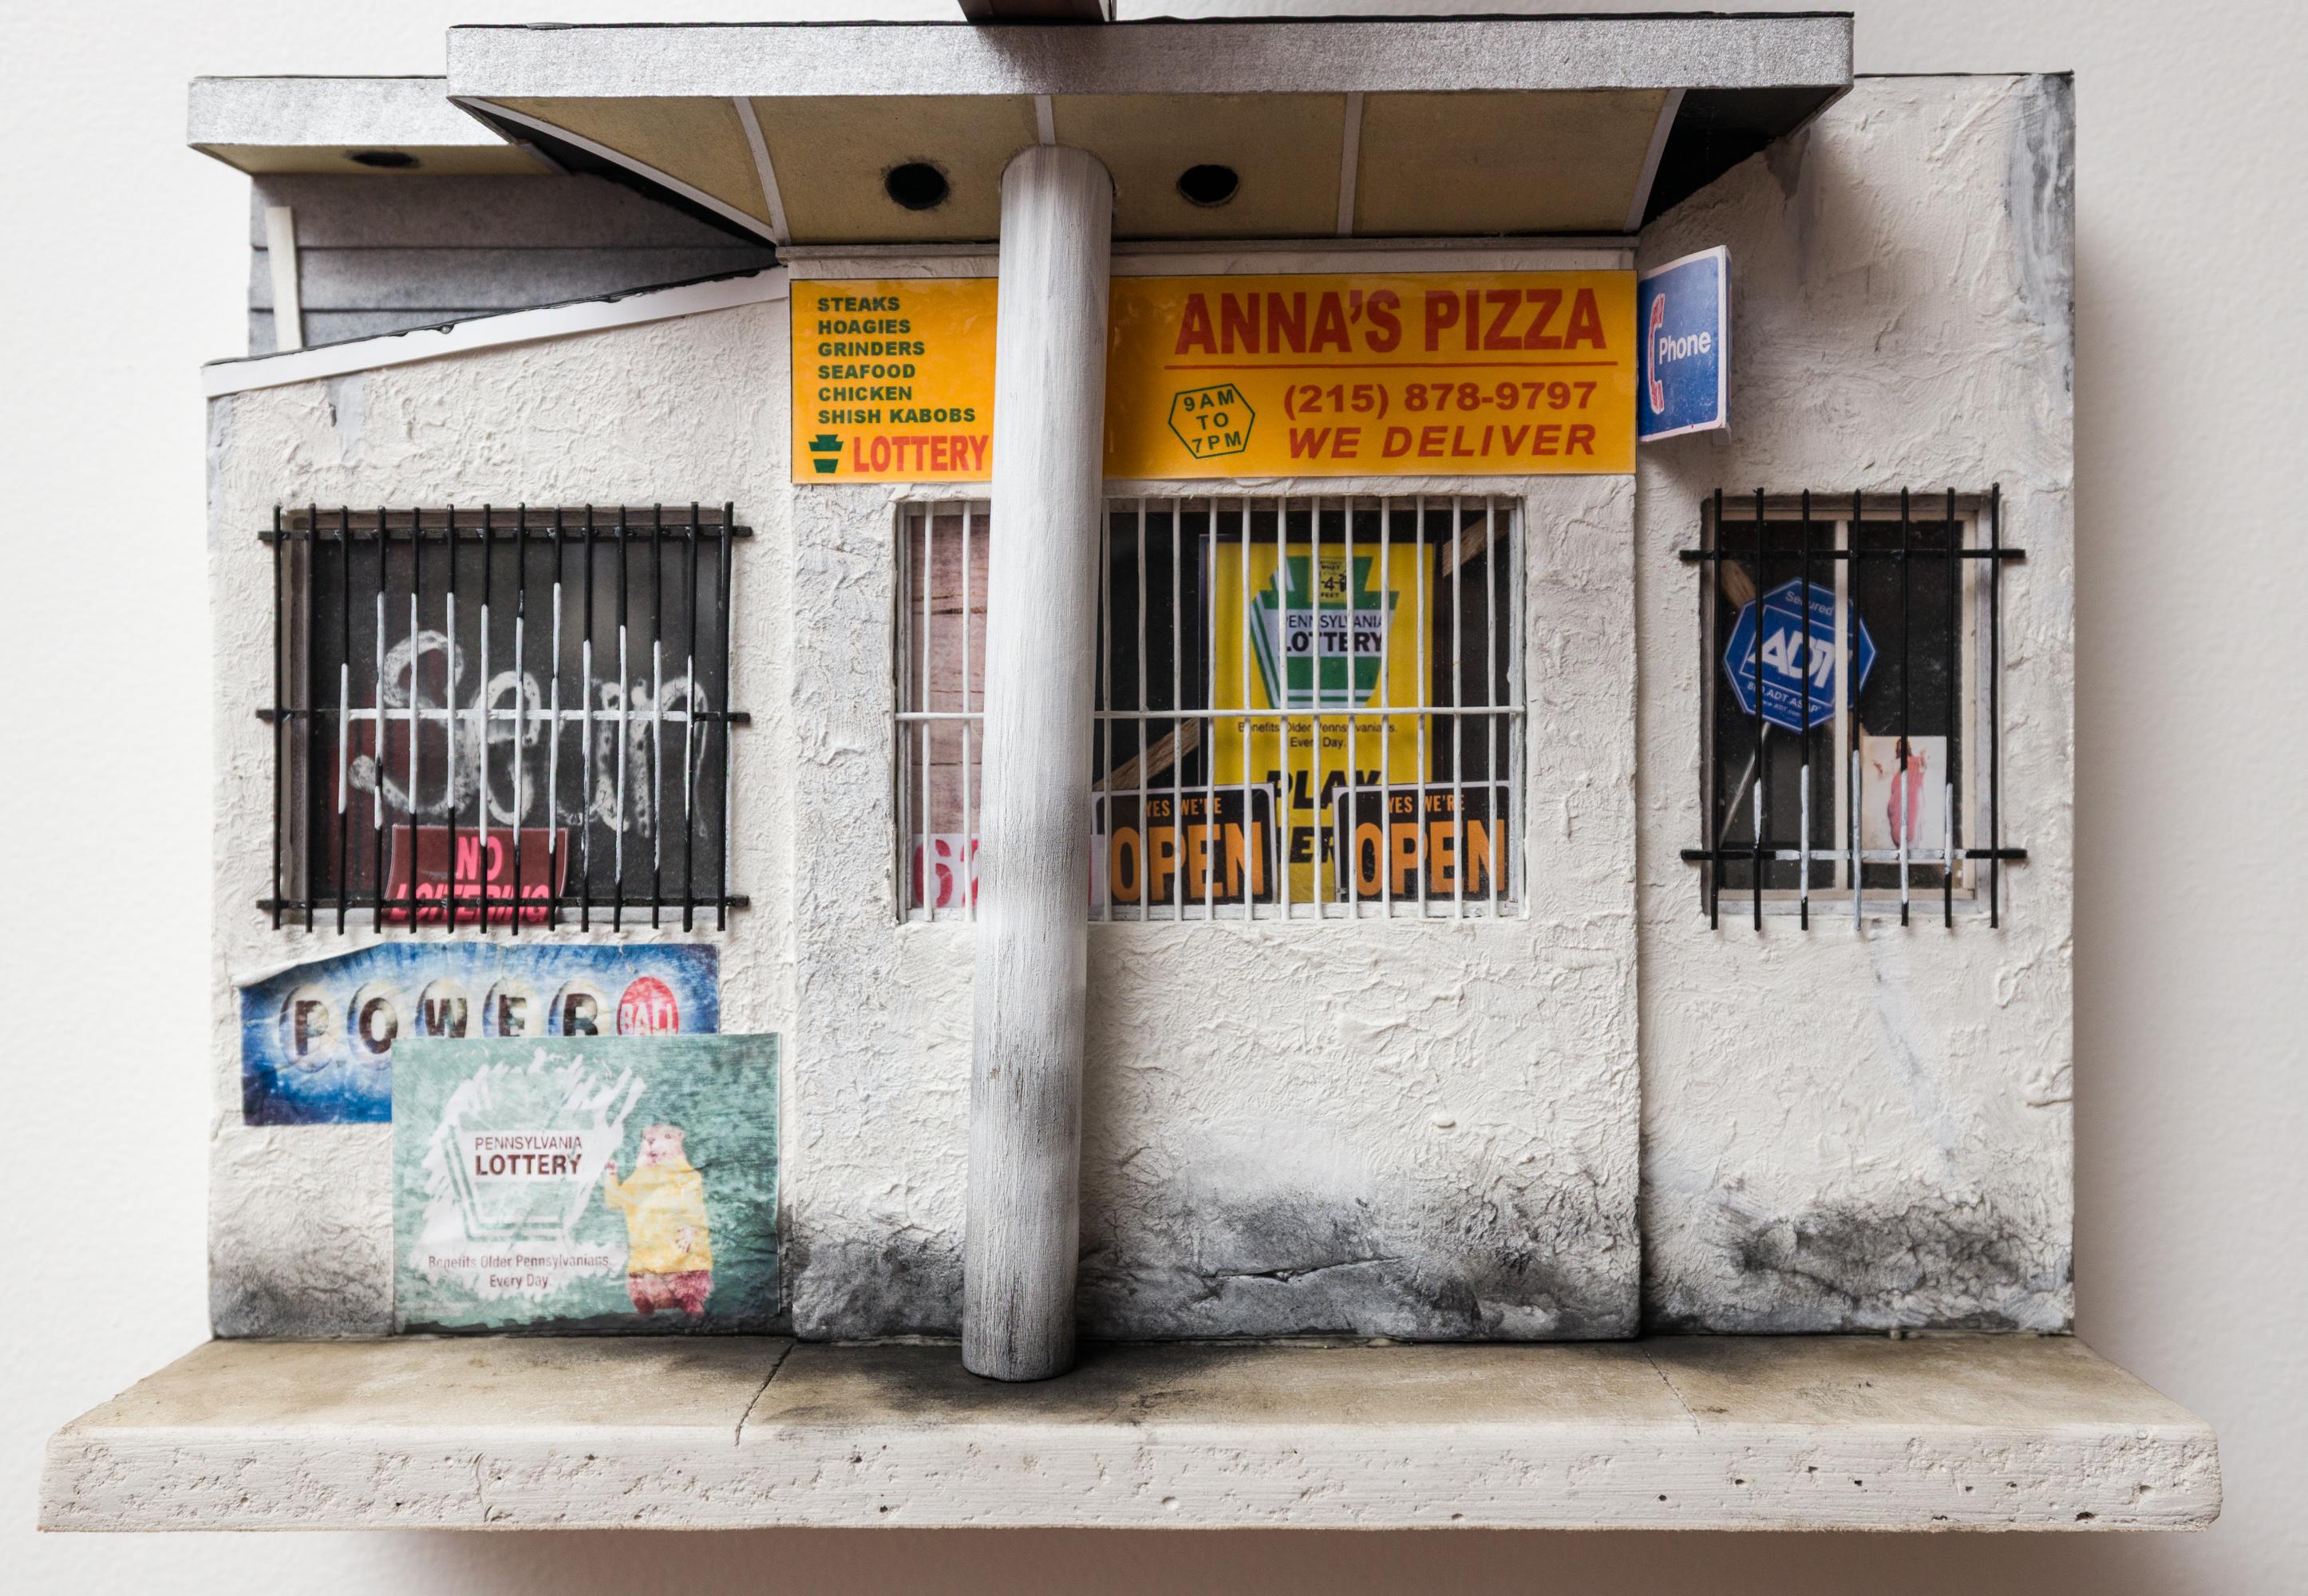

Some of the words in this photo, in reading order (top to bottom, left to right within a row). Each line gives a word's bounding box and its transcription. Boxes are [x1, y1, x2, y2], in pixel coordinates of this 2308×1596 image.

[817, 297, 900, 311] STEAKS
[818, 319, 911, 334] HOAGIES
[1175, 290, 1402, 354] ANNA'S
[1425, 288, 1607, 351] PIZZA
[818, 341, 925, 357] GRINDERS
[1659, 331, 1712, 365] Phone
[818, 364, 915, 379] SEAFOOD
[818, 386, 912, 401] CHICKEN
[1184, 389, 1235, 412] 9AM
[1284, 383, 1389, 421] (215)
[1404, 381, 1597, 411] 878-9797
[818, 409, 881, 424] SHISH
[889, 408, 975, 423] KABOBS
[1196, 412, 1229, 430] TO
[1192, 430, 1242, 453] 7PM
[1289, 427, 1361, 460] WE
[1381, 424, 1596, 458] DELIVER
[853, 435, 989, 472] LOTTERY
[1785, 591, 1835, 617] Seured
[1283, 631, 1383, 652] OTERY
[1747, 626, 1854, 688] ADT
[1238, 721, 1280, 733] Bnefits
[1290, 737, 1314, 748] Ever
[1146, 799, 1171, 818] YES
[1180, 797, 1223, 816] WE'E
[1387, 796, 1413, 814] YES
[456, 836, 503, 881] NO
[1110, 820, 1264, 902] OPEN
[1354, 819, 1506, 897] OPEN
[475, 1136, 583, 1150] PENNSYLVANIA
[475, 1153, 583, 1175] LOTTERY
[429, 1255, 476, 1268] Benefits
[480, 1254, 512, 1268] Older
[489, 1274, 522, 1289] Every
